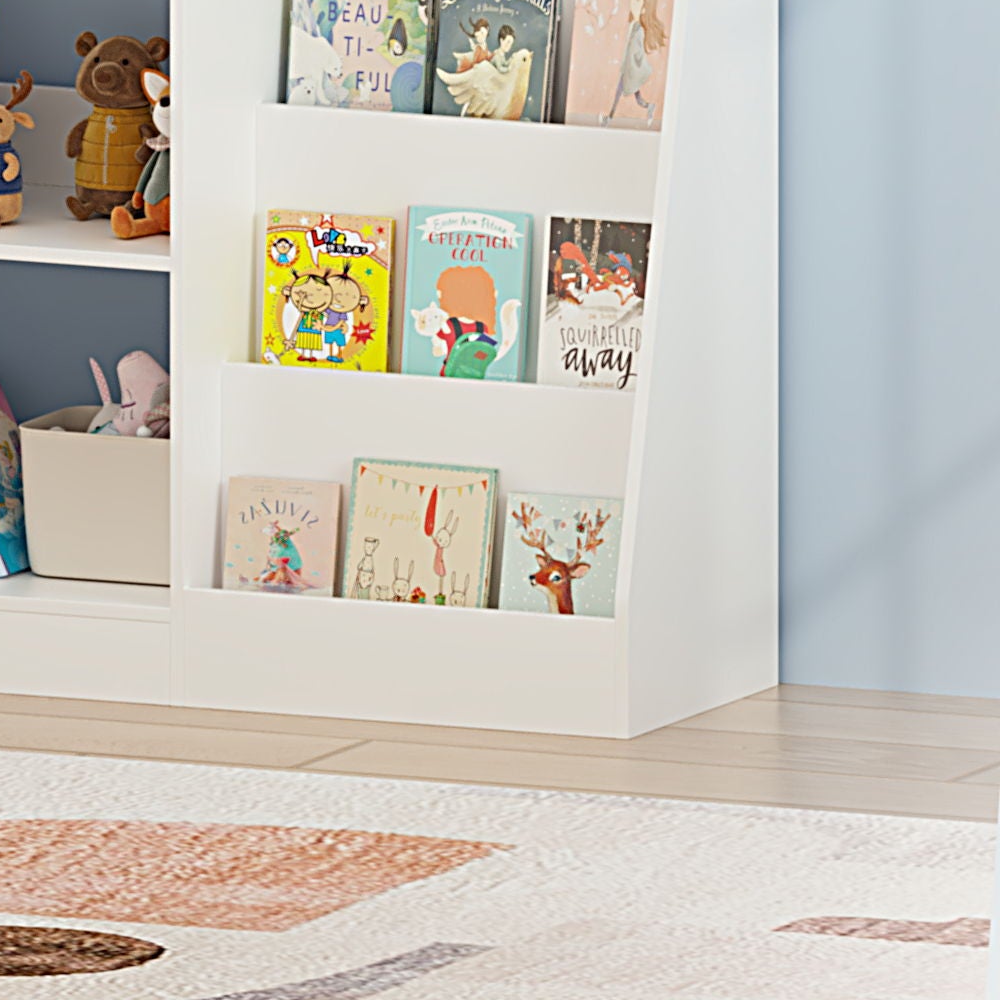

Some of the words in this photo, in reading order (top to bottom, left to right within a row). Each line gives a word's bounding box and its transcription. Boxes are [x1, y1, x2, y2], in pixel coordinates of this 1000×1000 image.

[355, 71, 392, 93] FUL
[428, 231, 513, 250] OPERATION
[451, 248, 488, 262] COOL
[560, 325, 642, 352] SQUIRRELLED
[561, 348, 638, 390] away
